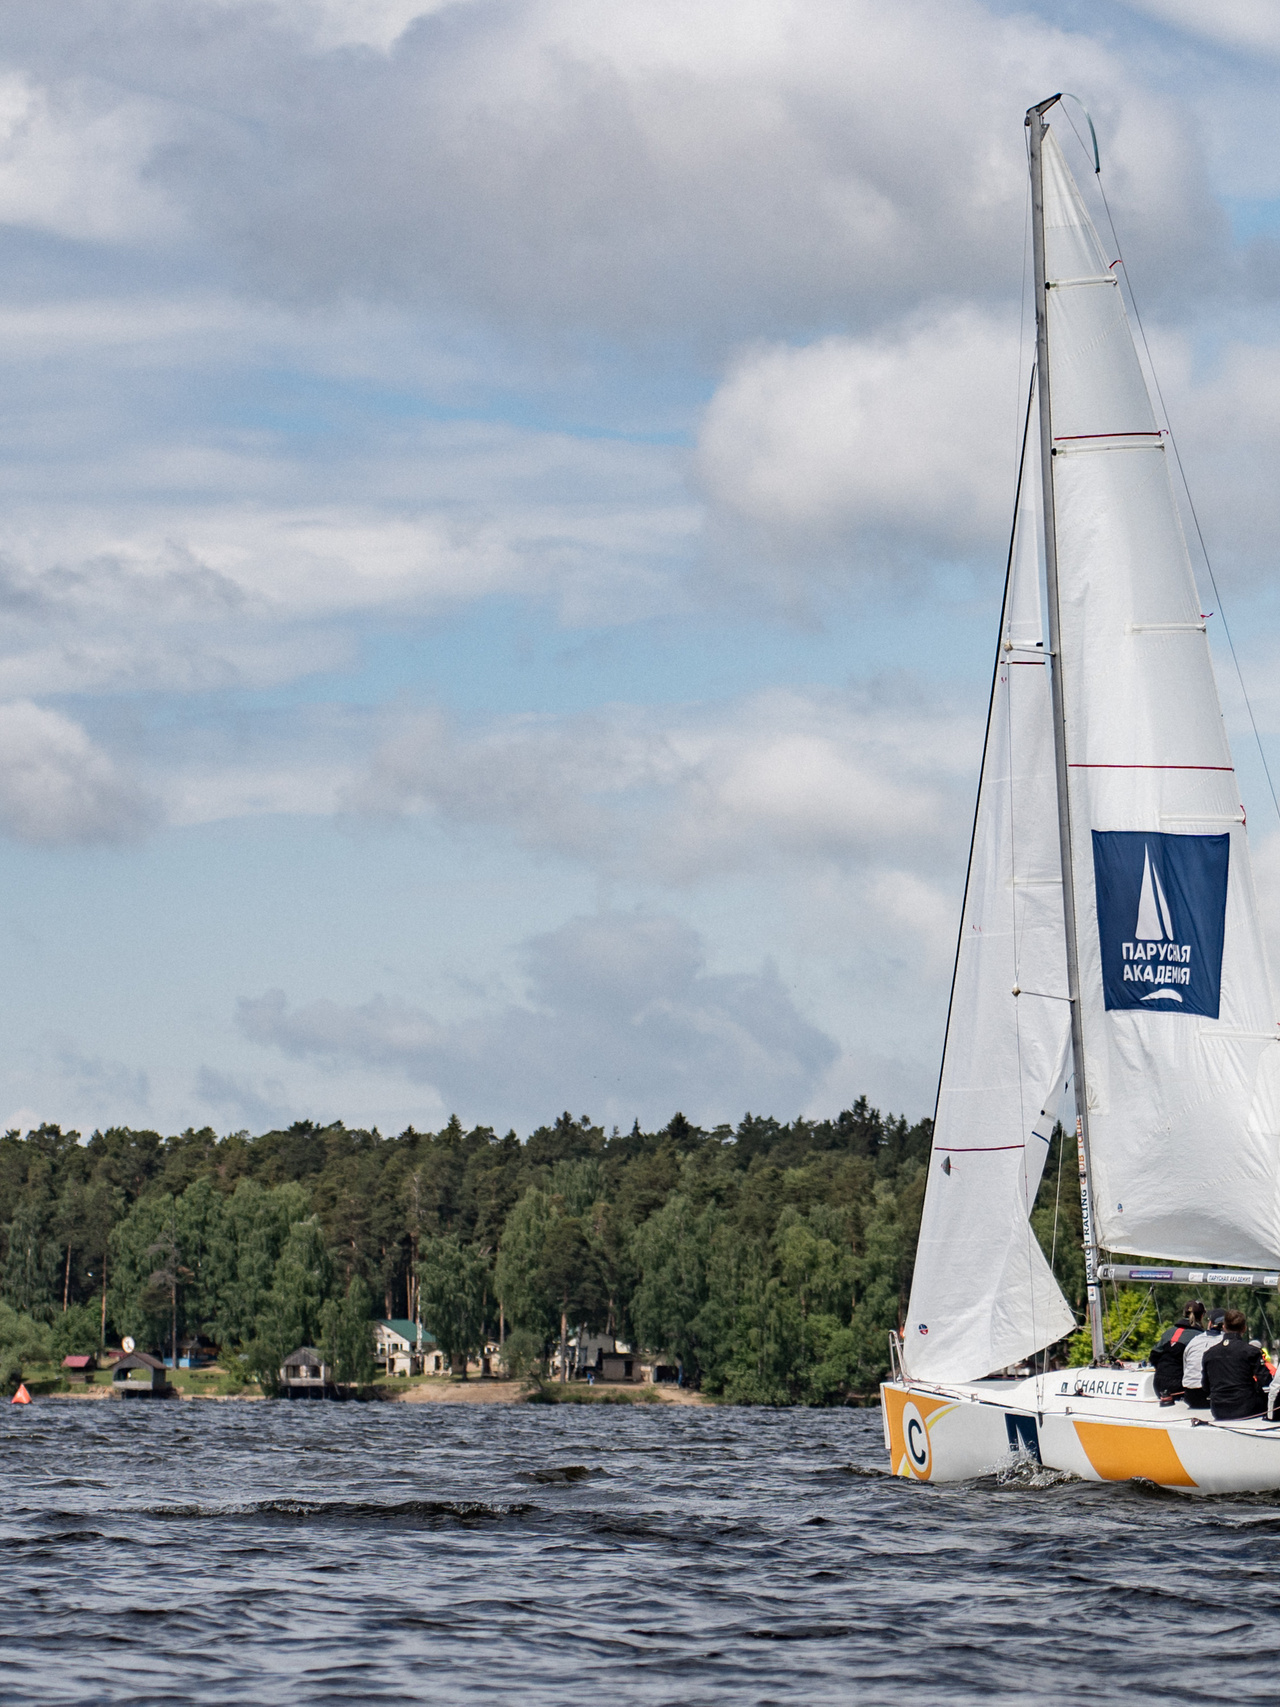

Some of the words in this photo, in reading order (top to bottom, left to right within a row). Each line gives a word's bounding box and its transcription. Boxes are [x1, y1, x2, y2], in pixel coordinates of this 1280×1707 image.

[1121, 942, 1191, 963] ПАРУСНАЯ
[1122, 963, 1191, 986] АКАДЕМИЯ
[1077, 1154, 1086, 1185] CUB
[1080, 1189, 1090, 1236] RACING
[1074, 1379, 1124, 1396] CHARLIE
[908, 1418, 926, 1465] C
